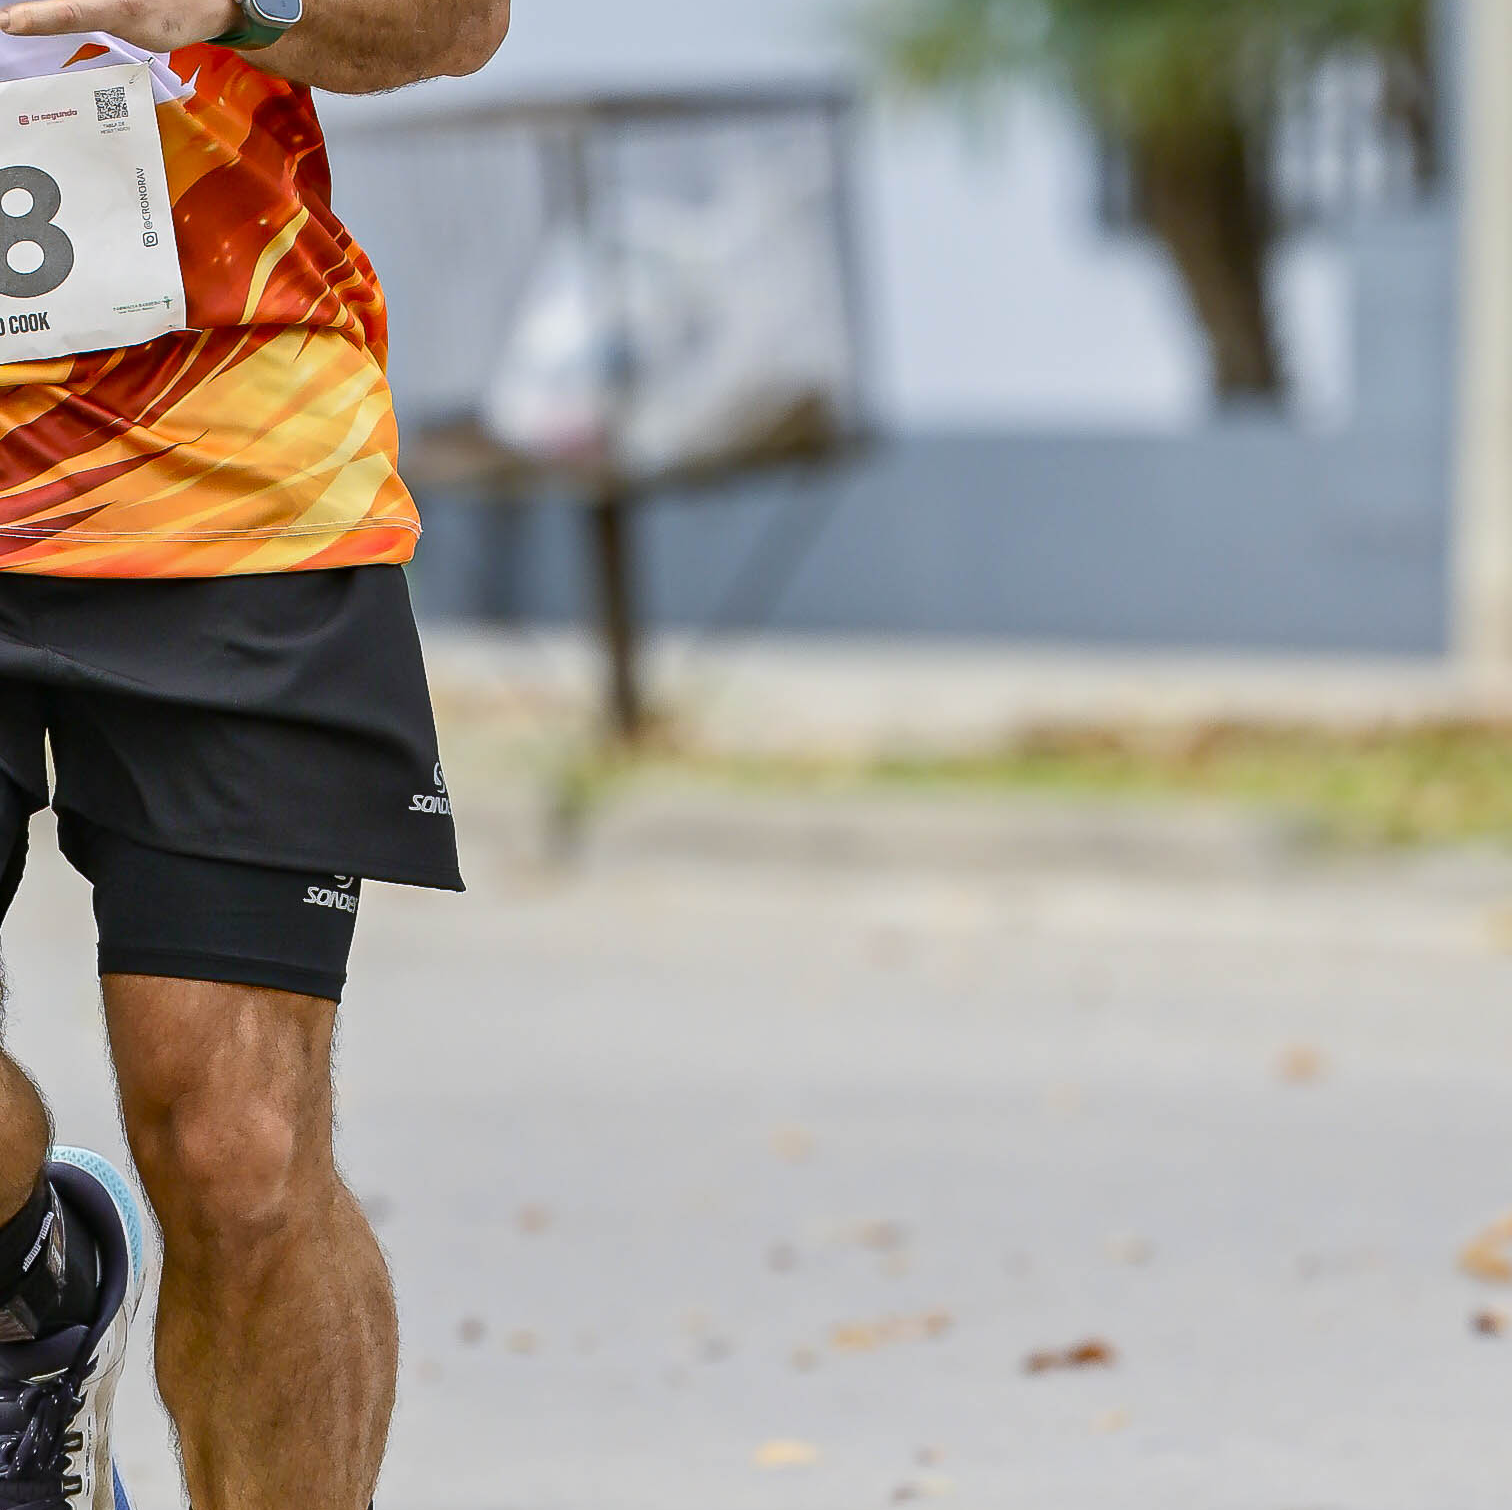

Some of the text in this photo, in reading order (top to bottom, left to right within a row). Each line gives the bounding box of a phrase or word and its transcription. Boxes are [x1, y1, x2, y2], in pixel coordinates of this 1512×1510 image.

[41, 109, 78, 121] segunda
[136, 167, 153, 229] @CRONORAV
[8, 312, 51, 335] COOK
